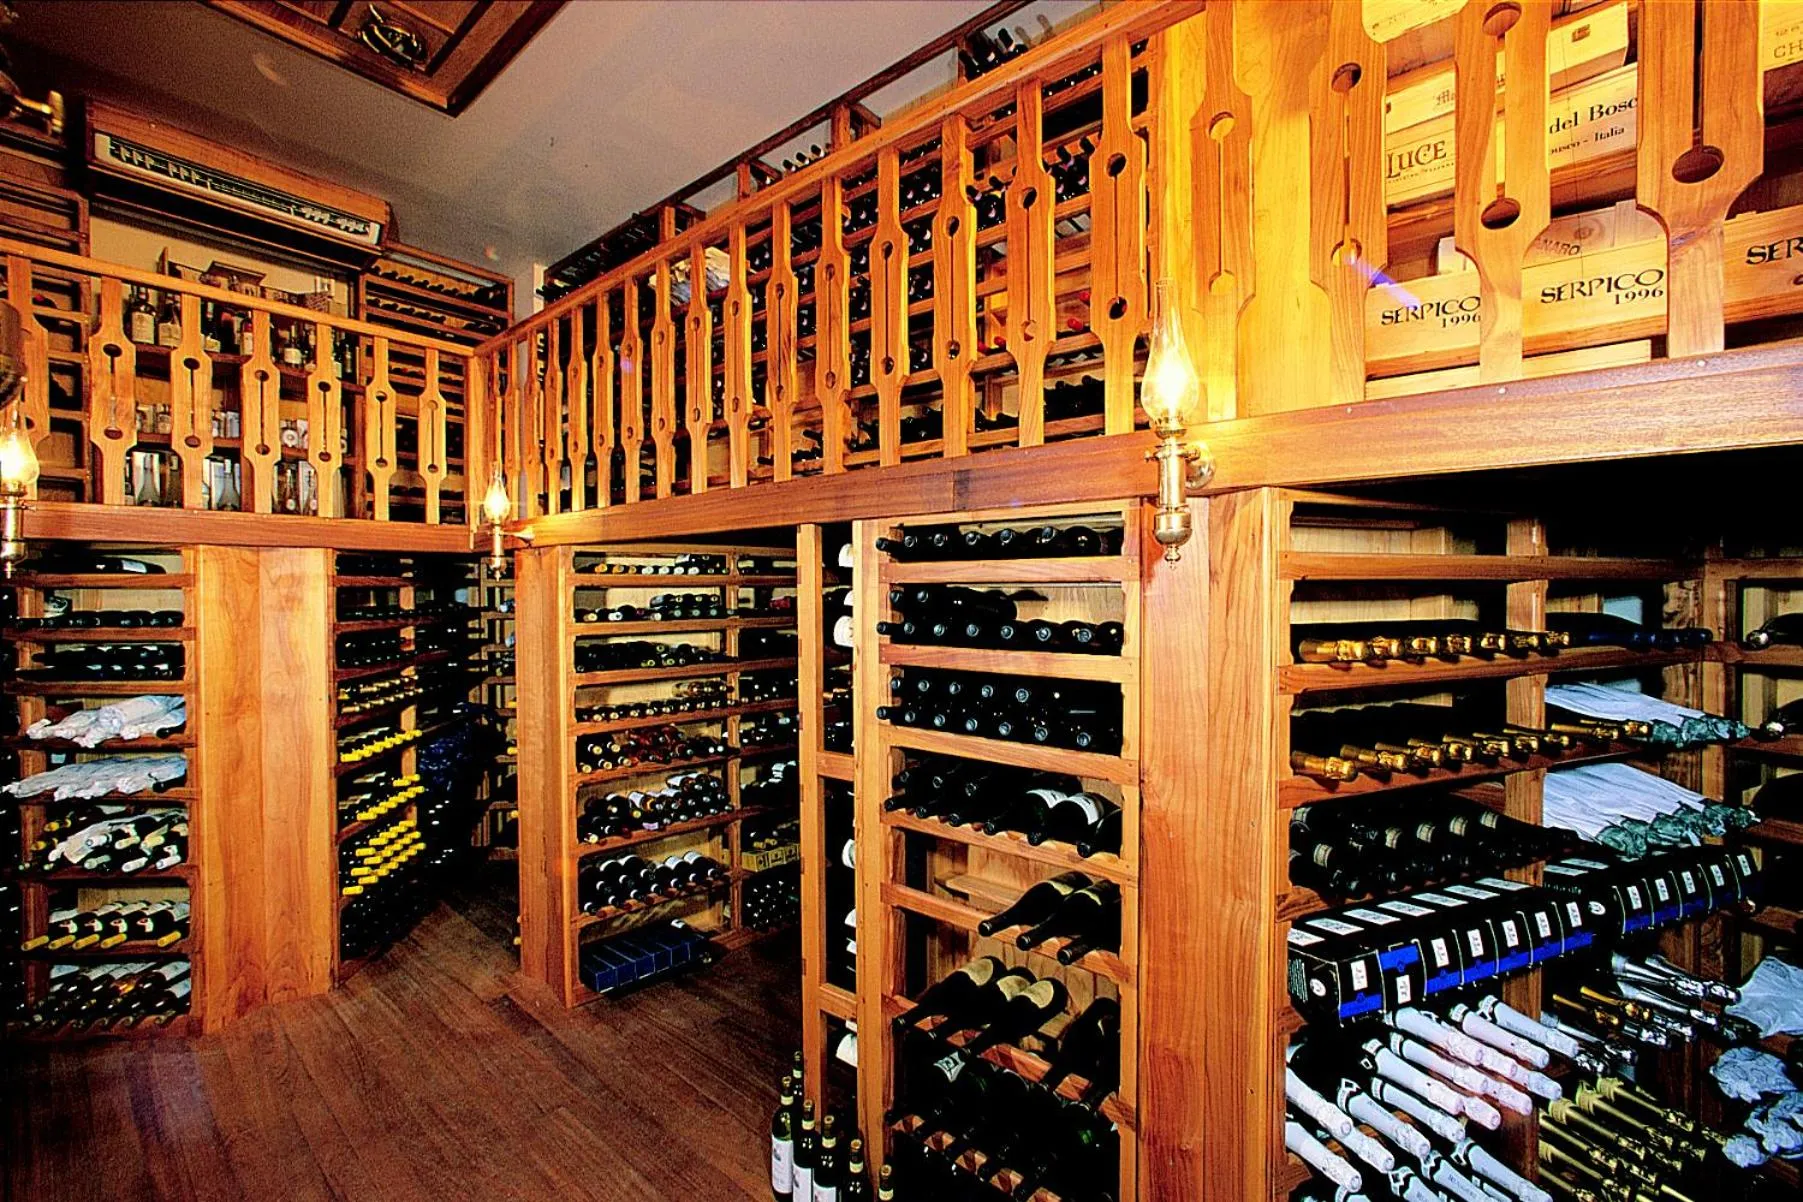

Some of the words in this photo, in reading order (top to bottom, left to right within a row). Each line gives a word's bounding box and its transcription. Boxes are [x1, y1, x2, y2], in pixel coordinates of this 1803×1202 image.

[1549, 111, 1578, 134] del
[1594, 126, 1625, 142] Italia
[1386, 140, 1447, 179] LUCE
[1541, 268, 1664, 304] SERPICO
[1614, 285, 1664, 305] 1996
[1380, 296, 1480, 326] SERPICO
[1441, 312, 1480, 328] 1996
